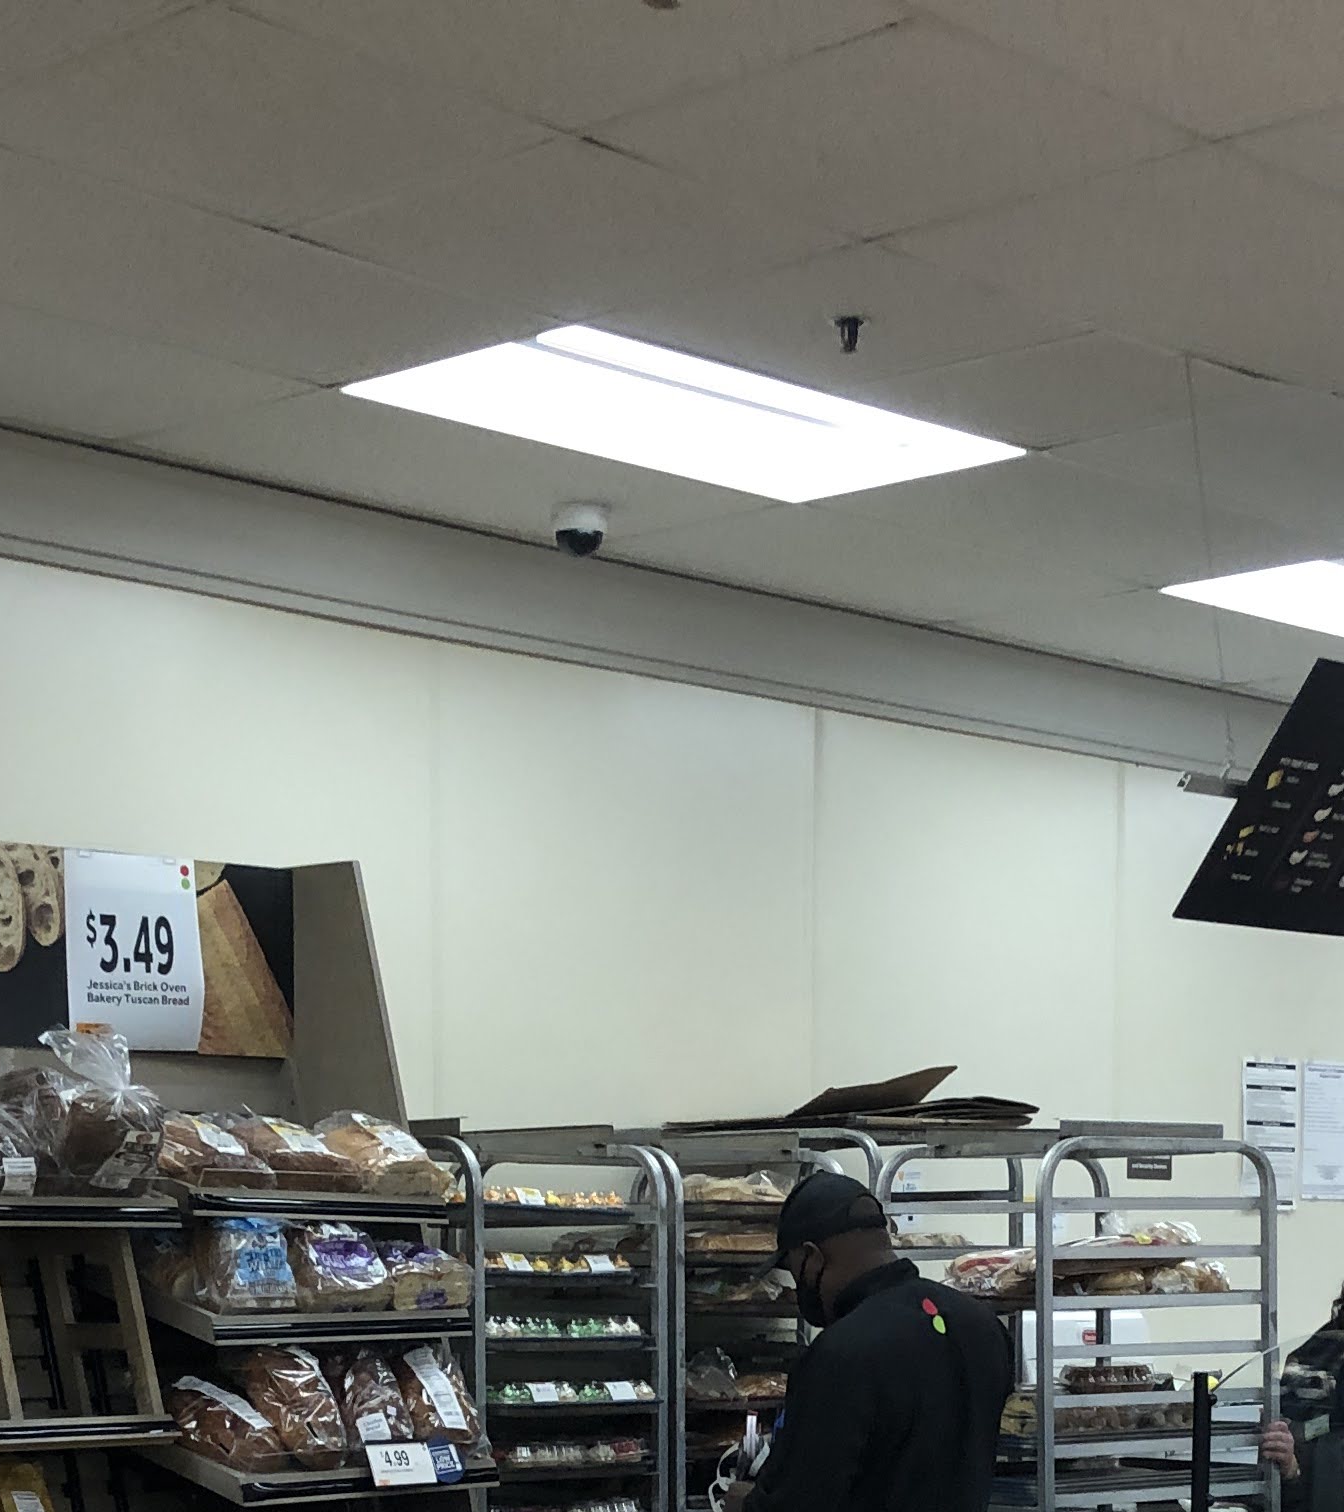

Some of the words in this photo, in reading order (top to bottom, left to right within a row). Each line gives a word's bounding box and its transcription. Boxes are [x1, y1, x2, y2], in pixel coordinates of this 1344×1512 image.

[86, 909, 174, 975] $3.49
[87, 980, 132, 991] Jessica's
[133, 981, 158, 992] Brick
[160, 982, 187, 993] Oven
[87, 992, 122, 1006] Bakery
[125, 994, 159, 1005] Tuscan
[161, 996, 190, 1006] Bread
